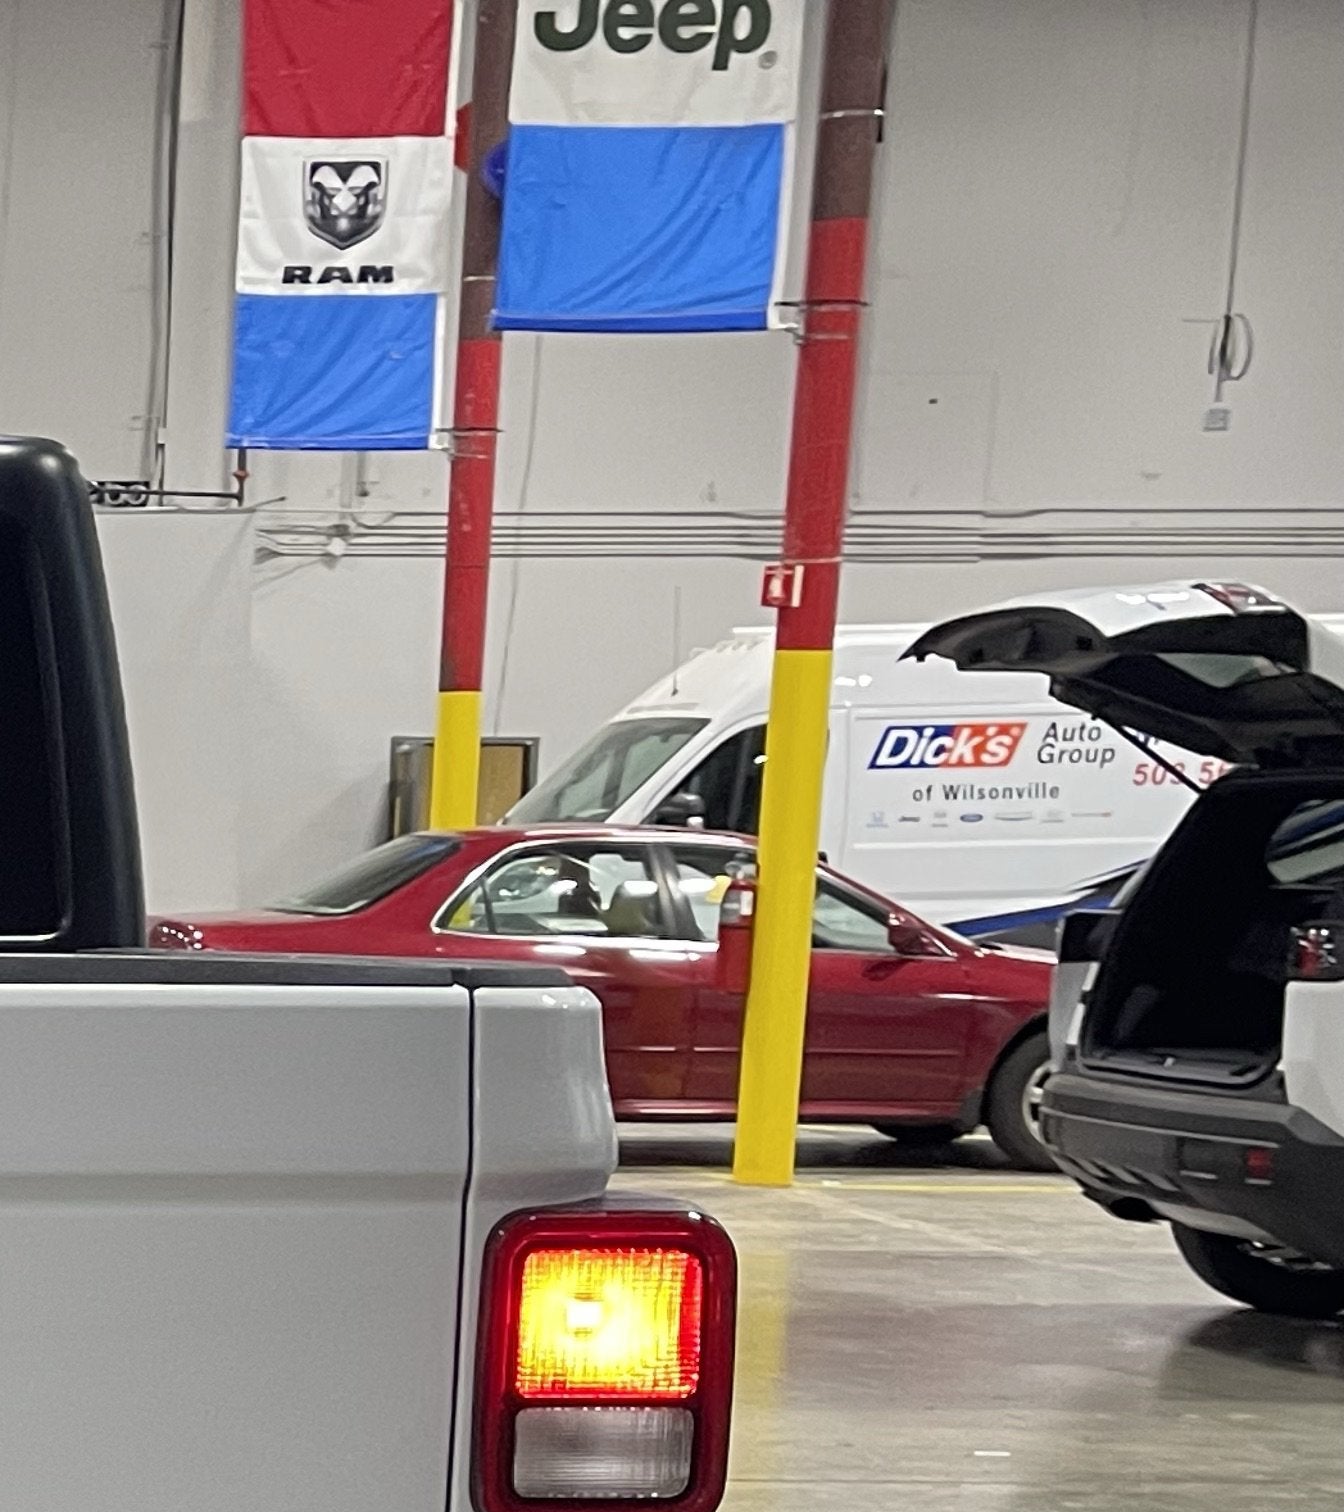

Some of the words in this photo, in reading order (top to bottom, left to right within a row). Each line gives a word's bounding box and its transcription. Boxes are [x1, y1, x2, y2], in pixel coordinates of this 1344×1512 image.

[533, 0, 772, 71] Jeep
[281, 264, 395, 284] RAM
[1042, 722, 1102, 743] Auto
[875, 726, 1015, 766] Dick's
[1037, 743, 1116, 769] Group
[912, 785, 933, 802] of
[942, 780, 1060, 801] Wilsonville
